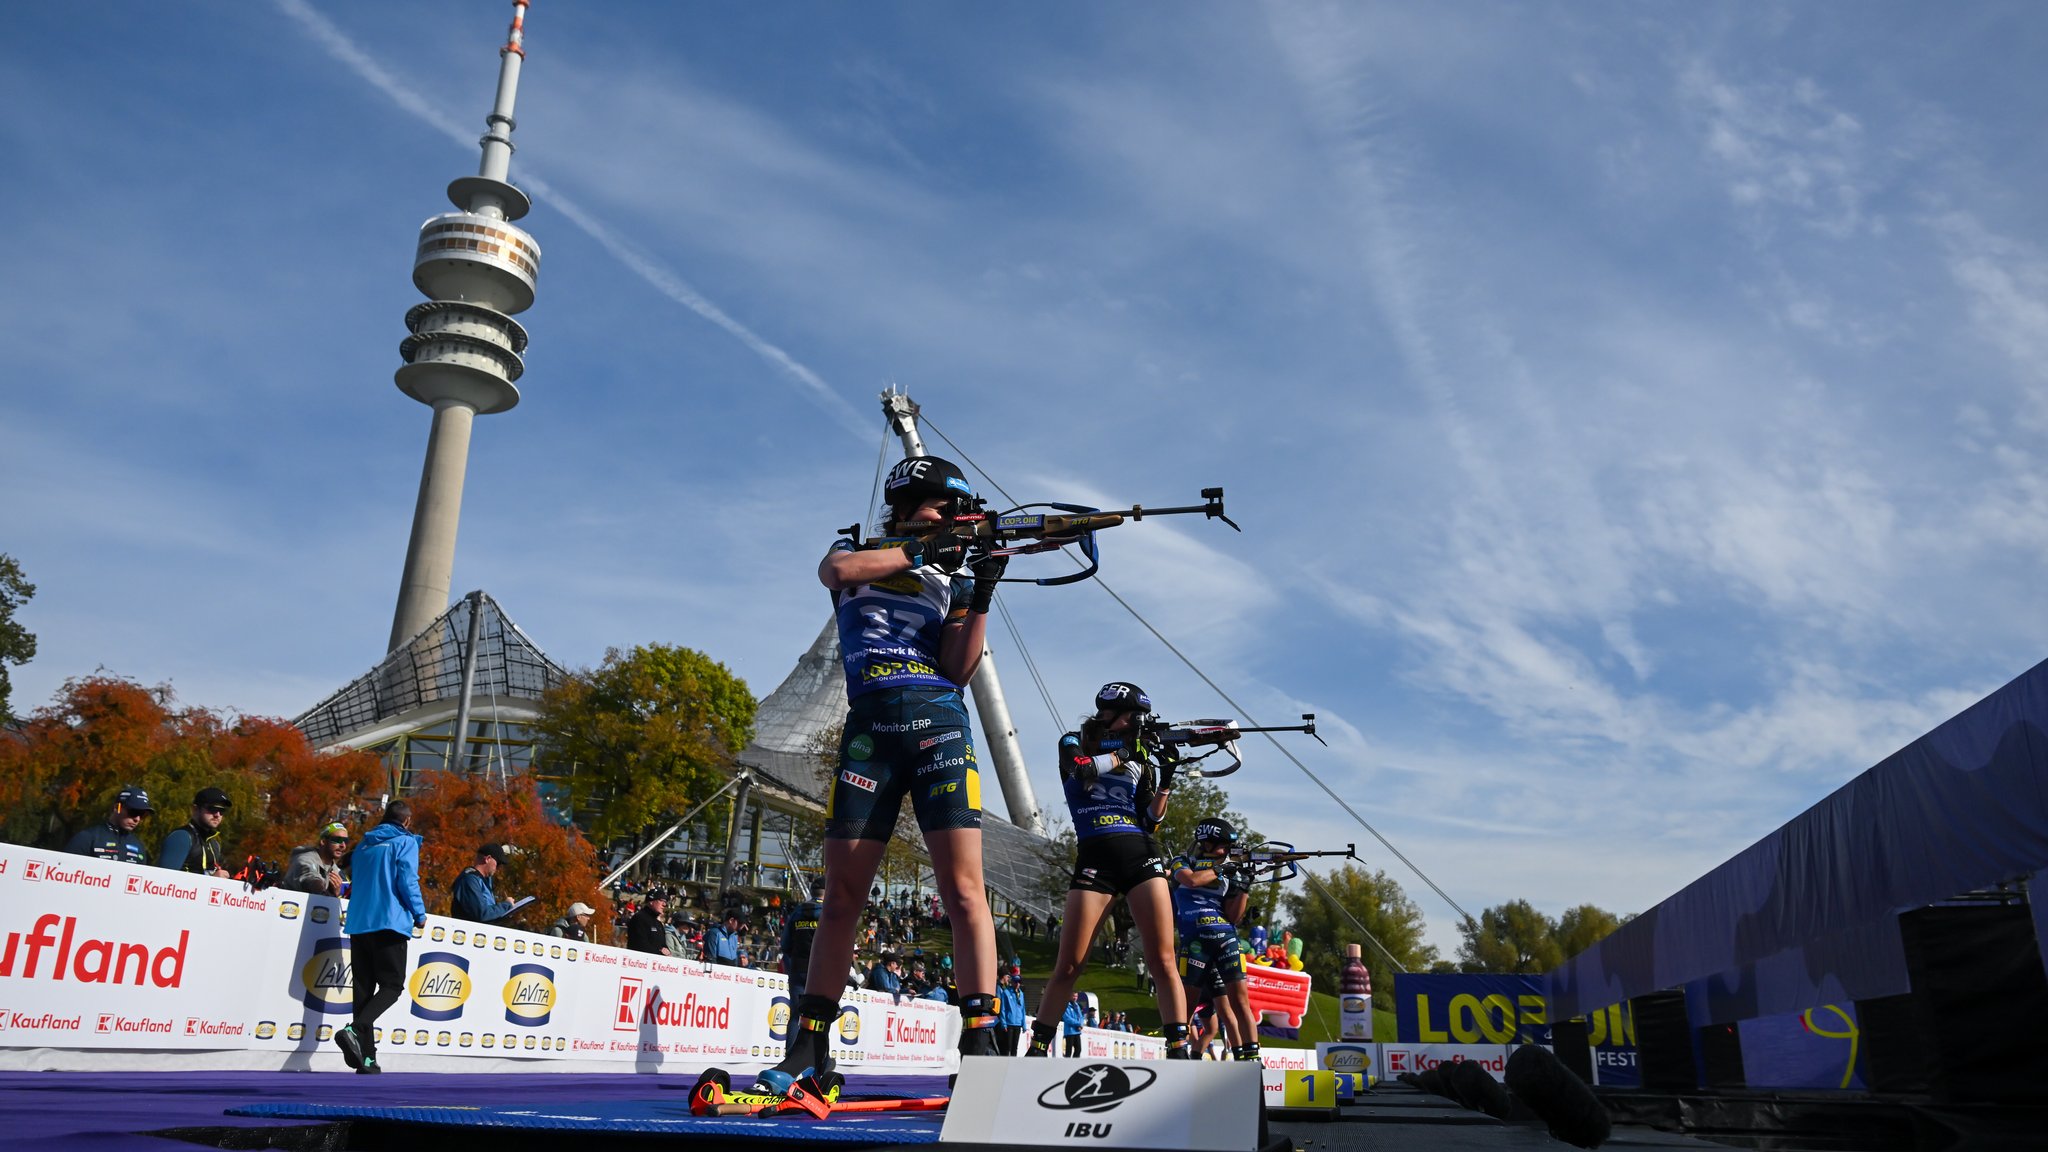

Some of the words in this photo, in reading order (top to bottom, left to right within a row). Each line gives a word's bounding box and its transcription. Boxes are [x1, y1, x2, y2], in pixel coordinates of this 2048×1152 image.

[886, 460, 932, 488] SWE
[860, 605, 926, 641] 37
[861, 662, 903, 680] LOOP
[889, 673, 916, 681] OPENING
[916, 673, 940, 681] FESTIVAL
[872, 721, 910, 733] Monitor
[912, 718, 932, 731] ERP
[917, 757, 965, 776] SVEASKOG
[843, 771, 876, 791] NIBE
[929, 782, 957, 797] ATG
[1196, 824, 1221, 838] SWE
[45, 865, 112, 888] Kaufland
[143, 880, 198, 901] Kaufland
[223, 892, 267, 912] Kaufland
[1259, 978, 1301, 992] Kaufland
[643, 987, 730, 1030] Kaufland
[11, 1013, 81, 1030] Kaufland
[115, 1017, 173, 1033] Kaufland
[200, 1020, 244, 1035] Kaufland
[896, 1018, 936, 1044] Kaufland
[1263, 1056, 1305, 1070] Kaufland
[1300, 1074, 1315, 1102] 1
[1063, 1122, 1112, 1140] IBU
